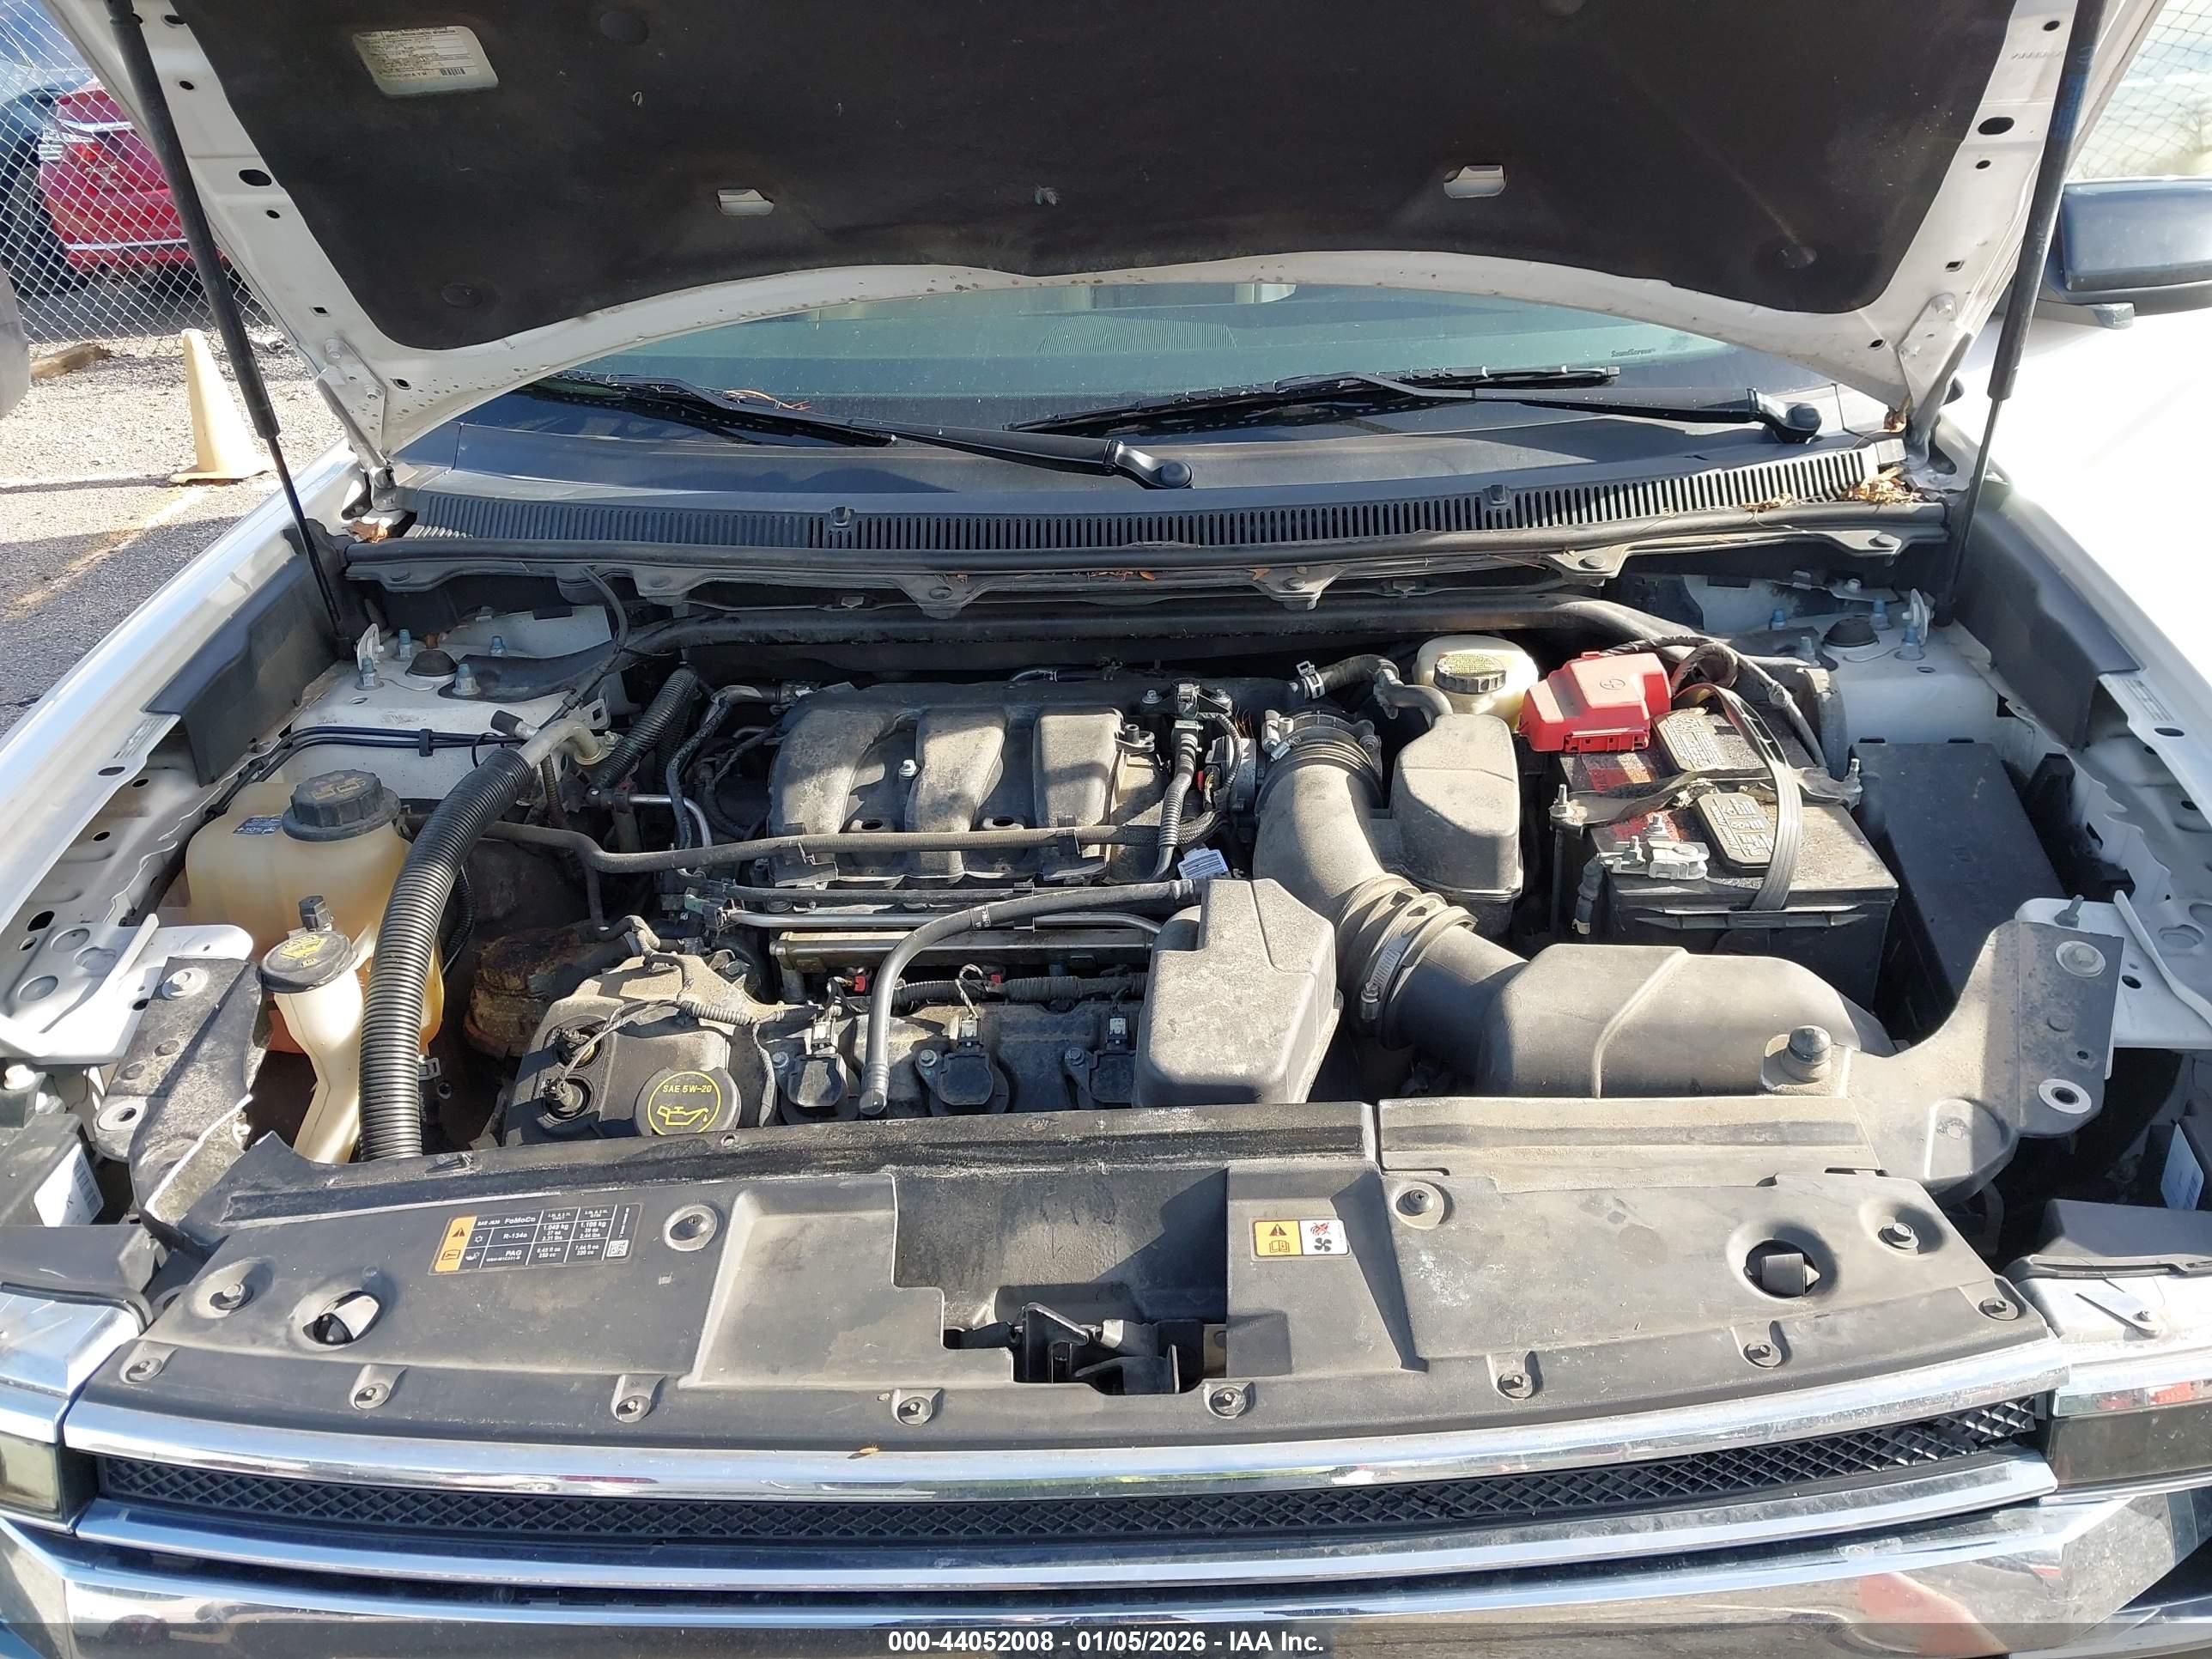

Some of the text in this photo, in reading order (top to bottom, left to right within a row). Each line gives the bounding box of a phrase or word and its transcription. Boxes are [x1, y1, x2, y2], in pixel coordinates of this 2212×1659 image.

[662, 1085, 713, 1093] SAE 5W-20
[504, 1216, 537, 1224] FoMoCo
[503, 1231, 528, 1240] R-134a
